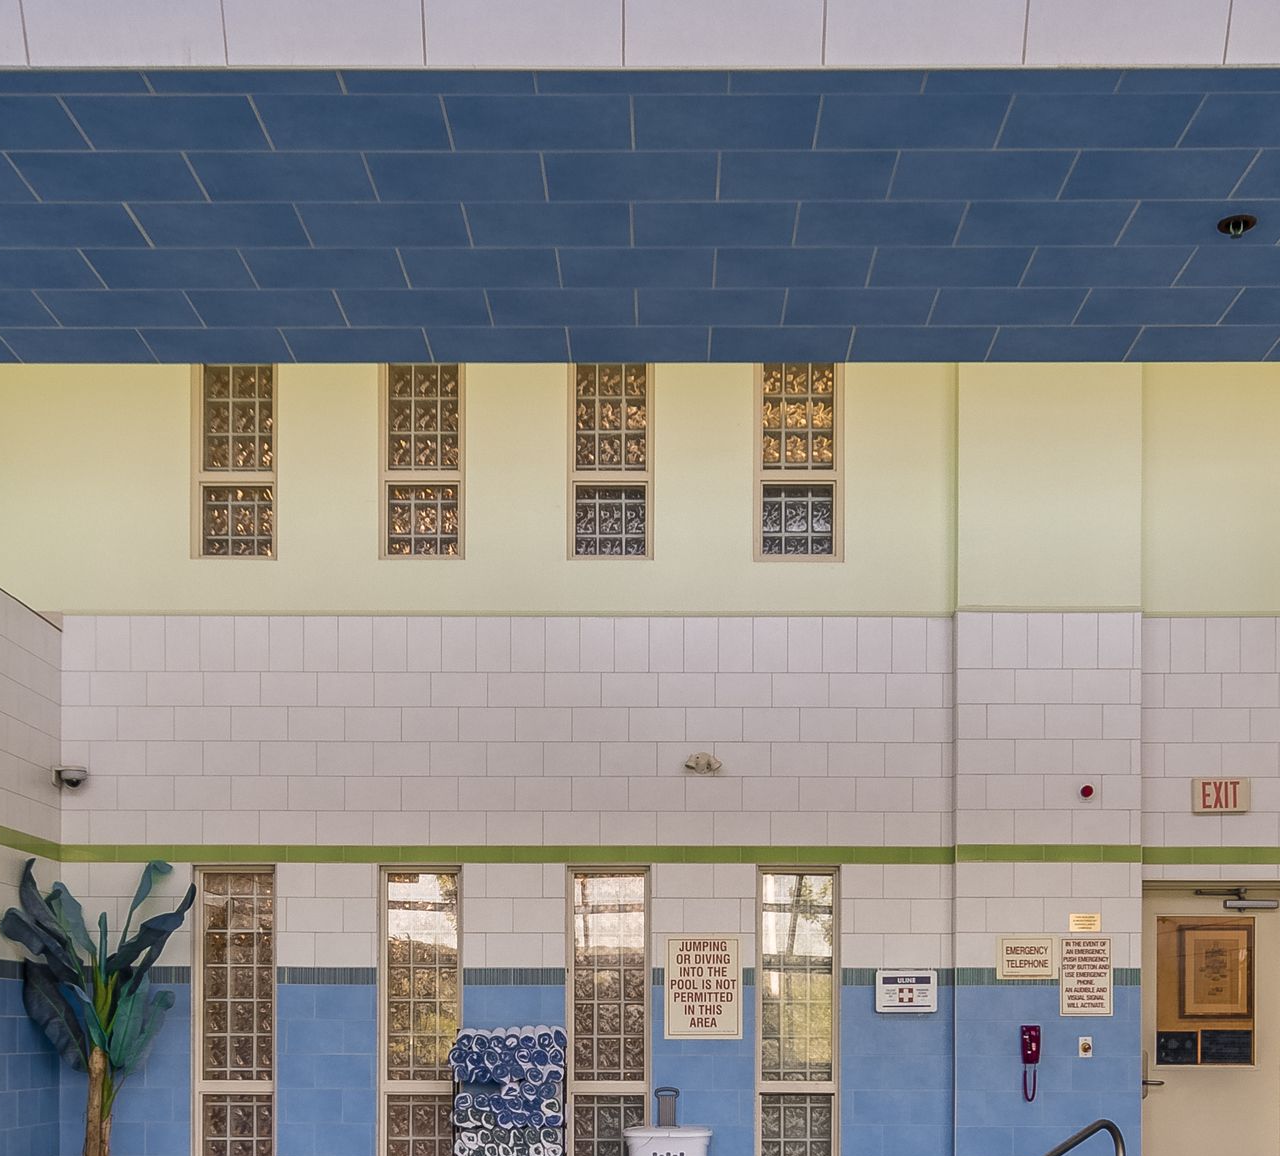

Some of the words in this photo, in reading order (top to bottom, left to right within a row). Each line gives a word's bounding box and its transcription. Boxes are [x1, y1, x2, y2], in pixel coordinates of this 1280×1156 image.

[1201, 781, 1240, 809] EXIT
[679, 941, 727, 952] JUMPING
[1006, 946, 1049, 955] EMERGENCY
[676, 954, 691, 965] OR
[694, 954, 731, 965] DIVING
[1006, 959, 1049, 968] TELEPHONE
[679, 967, 705, 977] INTO
[708, 967, 727, 977] THE
[670, 979, 699, 990] POOL
[702, 979, 712, 990] IS
[715, 979, 736, 990] NOT
[674, 992, 733, 1002] PERMITTED
[684, 1005, 695, 1015] IN
[698, 1005, 723, 1015] THIS
[689, 1017, 718, 1028] AREA
